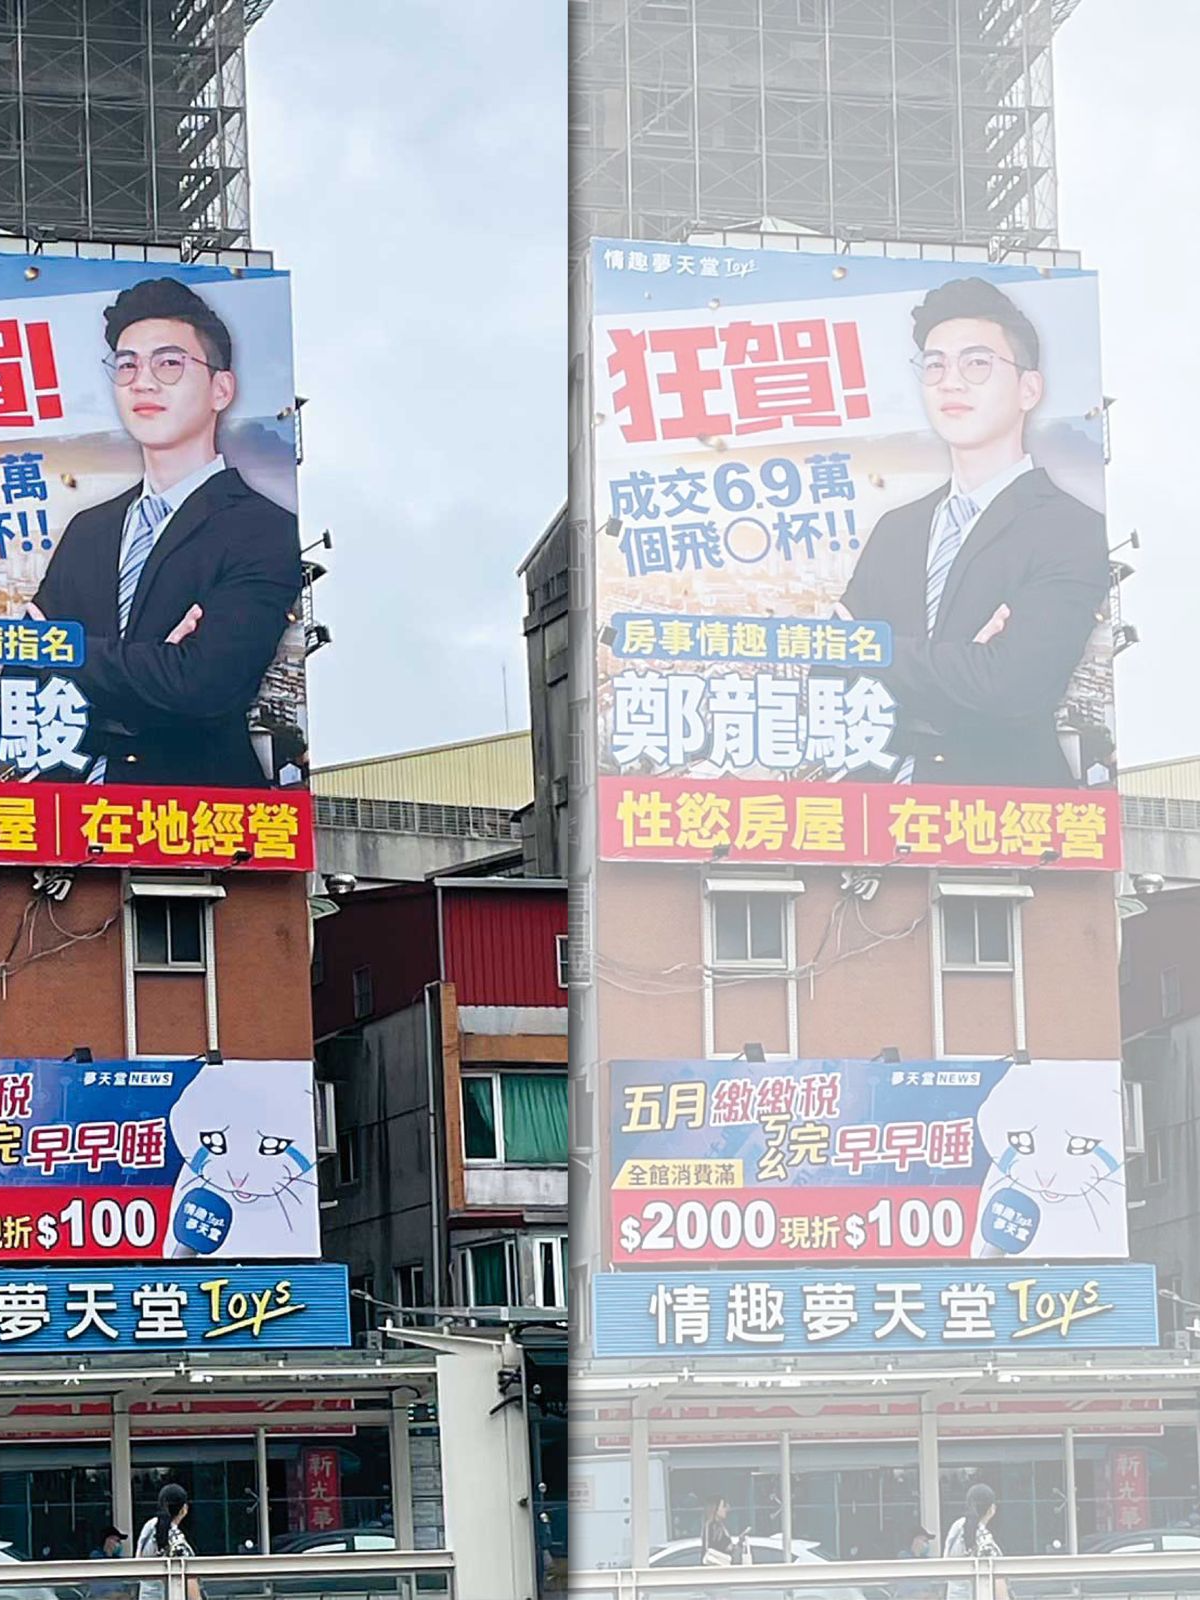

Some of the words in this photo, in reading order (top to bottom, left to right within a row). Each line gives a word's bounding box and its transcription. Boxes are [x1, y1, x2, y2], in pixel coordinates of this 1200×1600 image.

[604, 250, 720, 277] 情趣夢天堂
[608, 319, 872, 443] 狂賀!
[612, 669, 898, 771] 鄭龍駿
[81, 797, 298, 860] 在地經營
[617, 790, 846, 852] 性慾房屋
[889, 797, 1106, 860] 在地經營
[130, 1073, 171, 1085] NEWS
[628, 1165, 735, 1187] 全館消費滿
[201, 1278, 306, 1338] Toys
[649, 1281, 996, 1345] 情趣夢天堂
[1009, 1278, 1114, 1338] Toys
